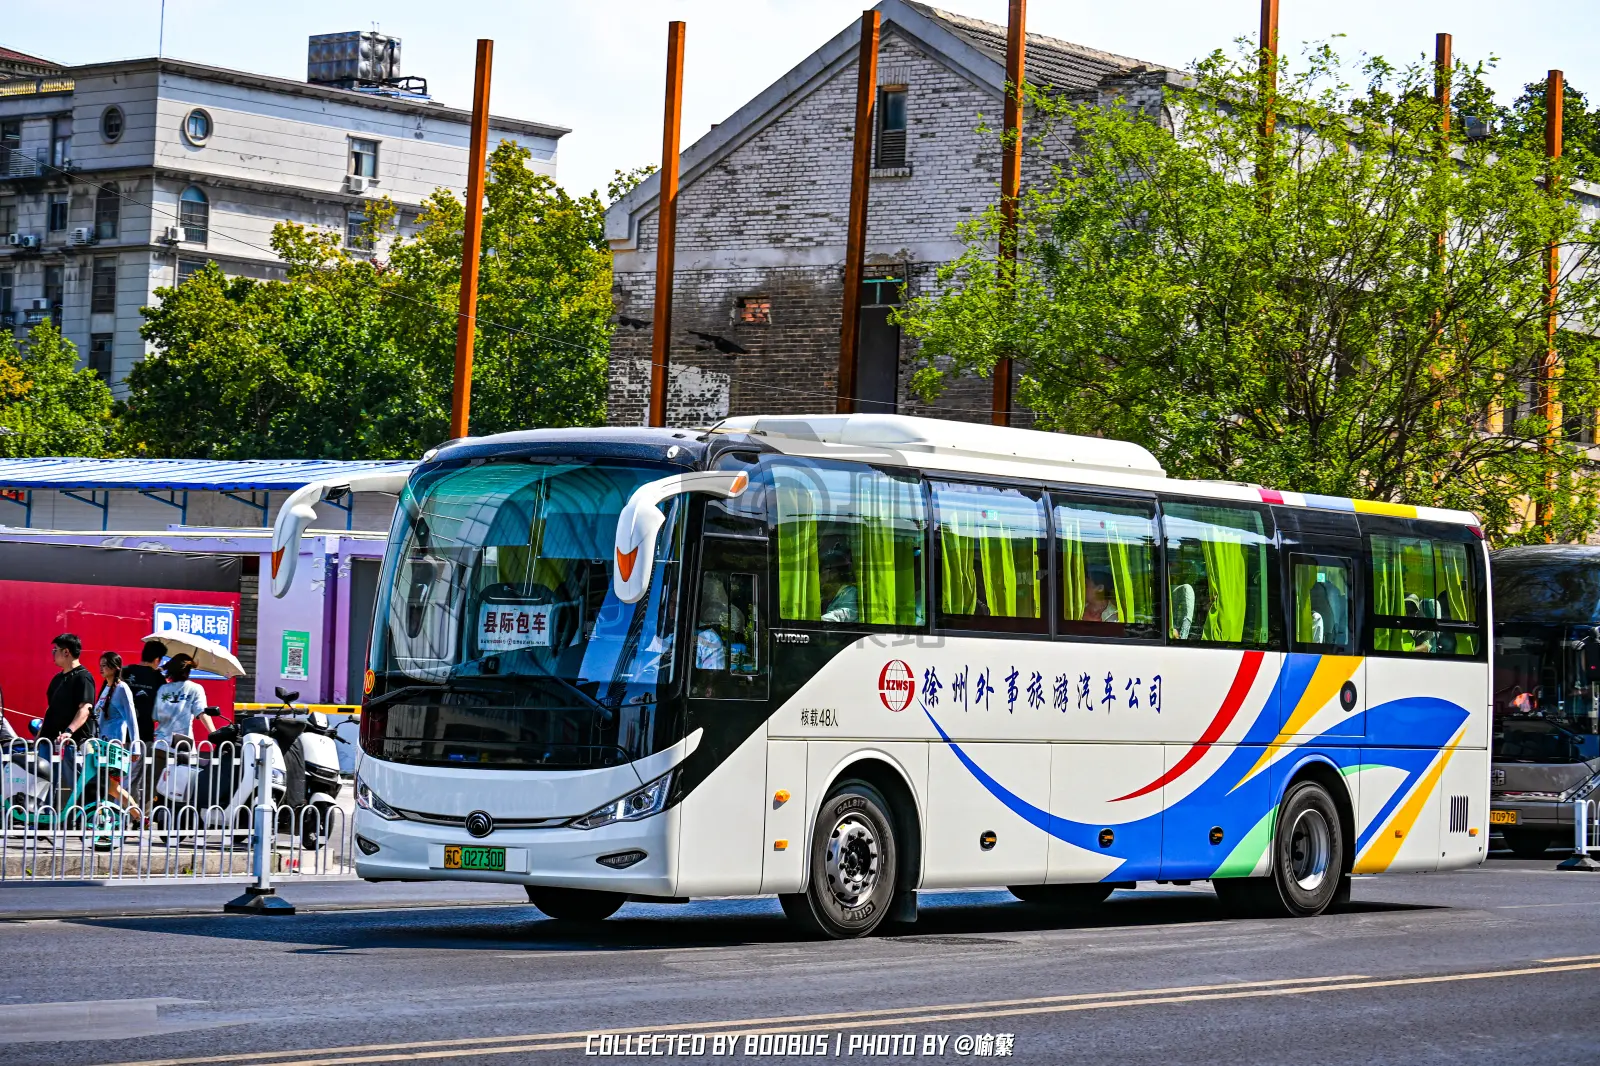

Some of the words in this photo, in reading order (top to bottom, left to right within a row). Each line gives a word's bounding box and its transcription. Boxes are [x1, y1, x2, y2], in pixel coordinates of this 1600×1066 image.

[178, 613, 229, 635] 南枫民宿
[483, 611, 547, 635] 县际包车
[774, 632, 810, 644] YUTONG
[885, 679, 909, 691] XZWS
[921, 664, 1163, 715] 徐州外事旅游汽车公司
[800, 708, 839, 727] 核载48人
[1491, 812, 1515, 823] T0978
